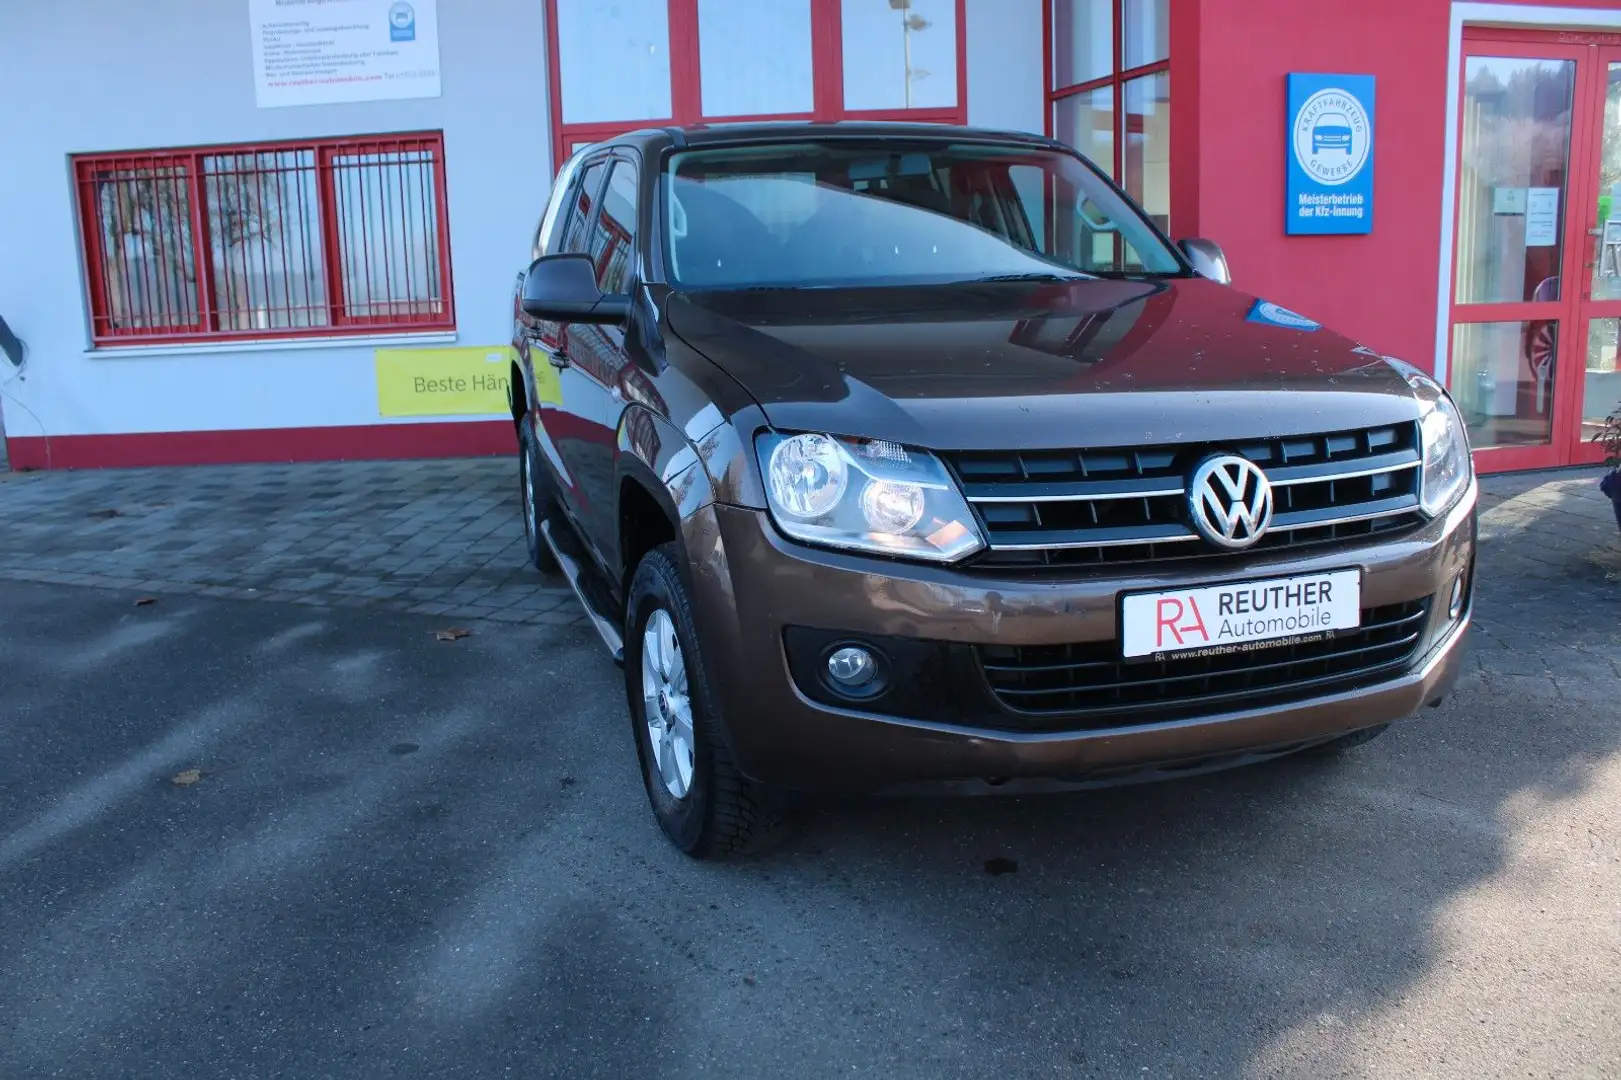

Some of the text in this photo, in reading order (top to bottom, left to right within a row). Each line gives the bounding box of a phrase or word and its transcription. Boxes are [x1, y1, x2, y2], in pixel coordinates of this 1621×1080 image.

[1302, 98, 1363, 132] KRAFTFAHRZEUG
[1310, 160, 1353, 177] GEWERBE
[1298, 193, 1364, 206] Meisterbetrieb
[1298, 206, 1364, 219] der Kfz-Innung
[413, 373, 508, 393] Beste Hän
[1156, 580, 1333, 648] RA REUTHER
[1217, 608, 1331, 639] Automobile
[1171, 633, 1322, 660] www.reuther-automobile.com
